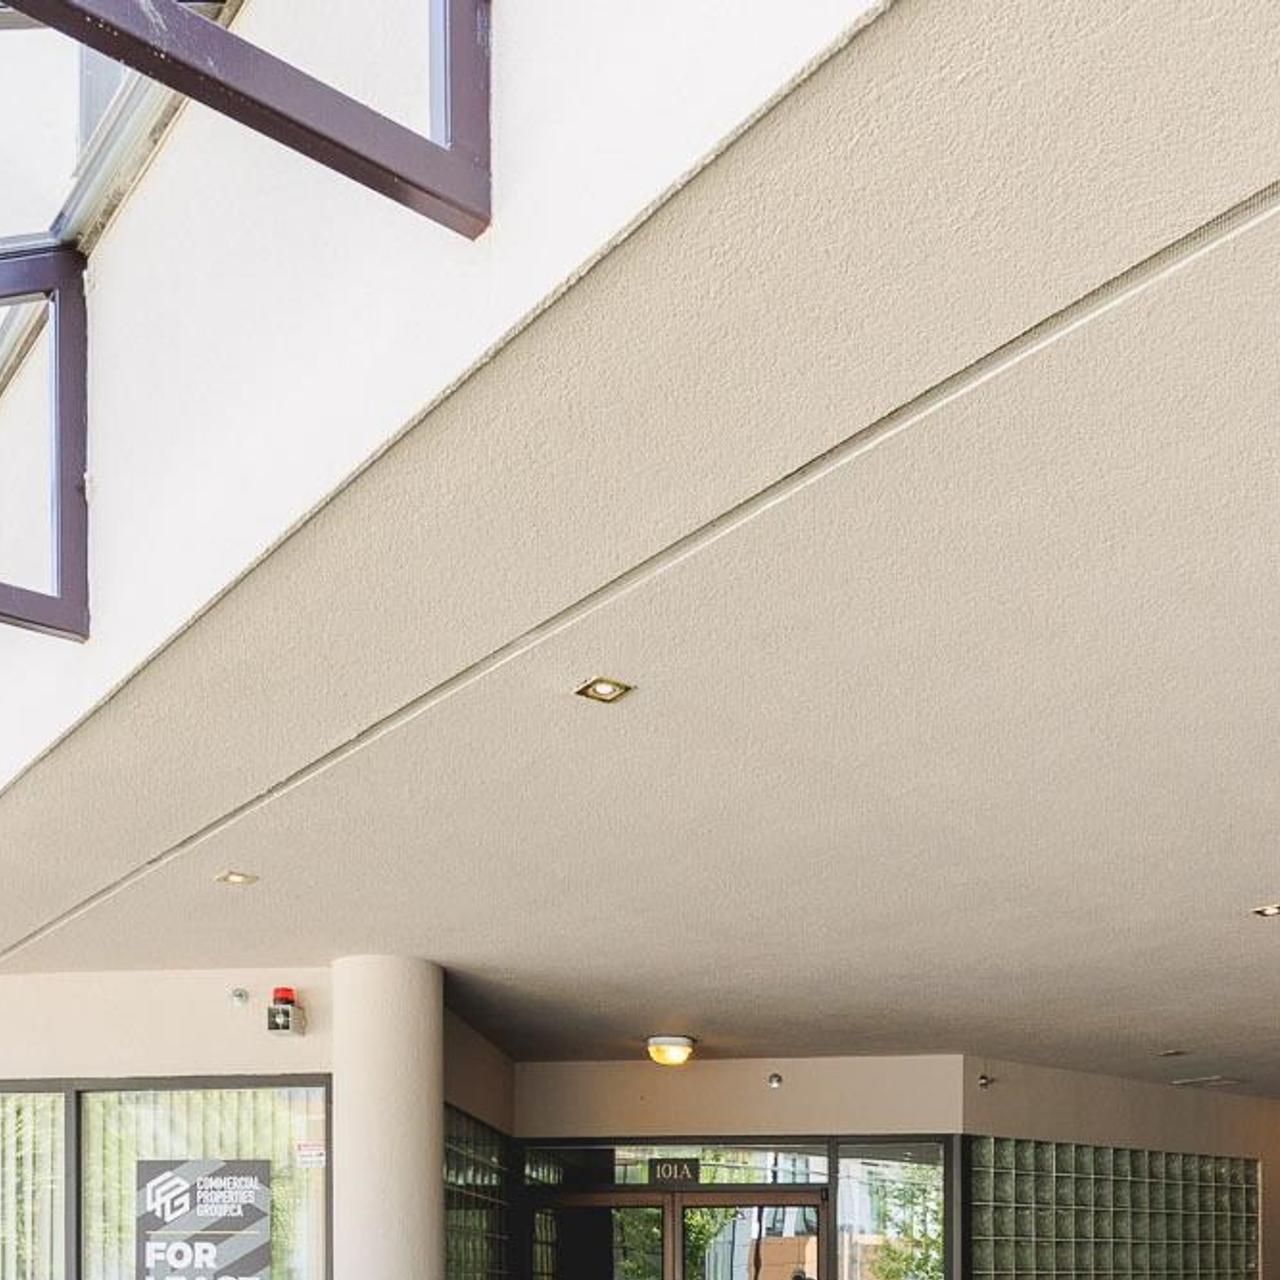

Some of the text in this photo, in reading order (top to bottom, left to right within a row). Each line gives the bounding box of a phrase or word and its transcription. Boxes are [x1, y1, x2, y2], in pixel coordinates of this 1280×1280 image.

[656, 1163, 692, 1179] 101A
[196, 1176, 259, 1190] COMMERCIAL
[196, 1190, 255, 1203] PROPERTIES
[145, 1241, 217, 1269] FOR
